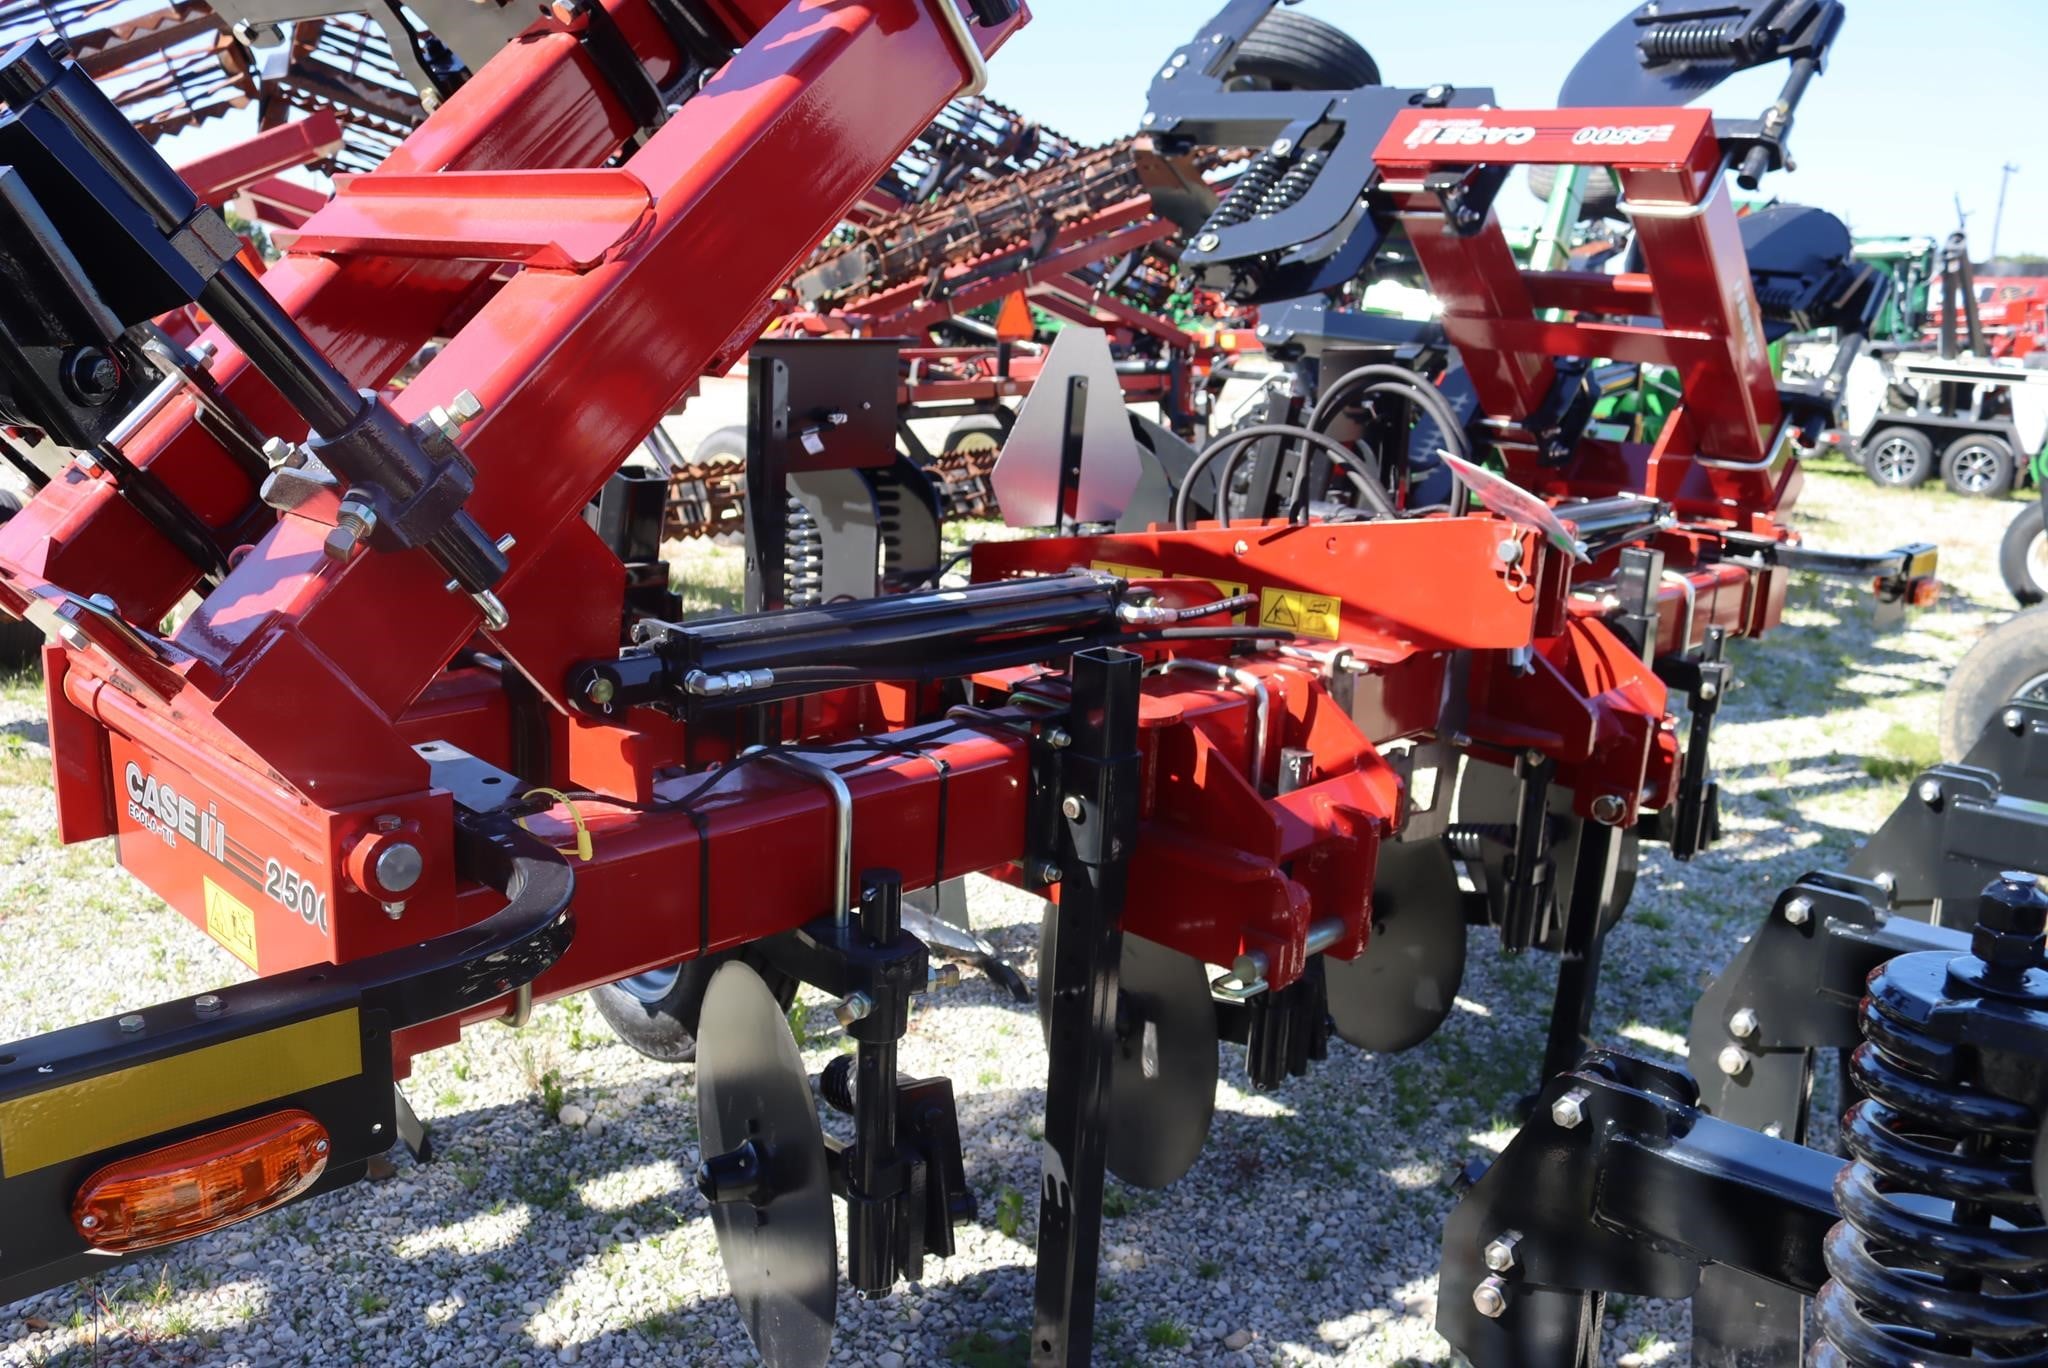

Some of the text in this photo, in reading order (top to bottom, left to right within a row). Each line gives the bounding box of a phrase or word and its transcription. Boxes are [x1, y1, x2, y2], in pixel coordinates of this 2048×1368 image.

[1435, 126, 1536, 146] CASE
[1572, 126, 1658, 146] 2500
[126, 761, 196, 843] CASE
[128, 800, 177, 849] ECOLO-TIL
